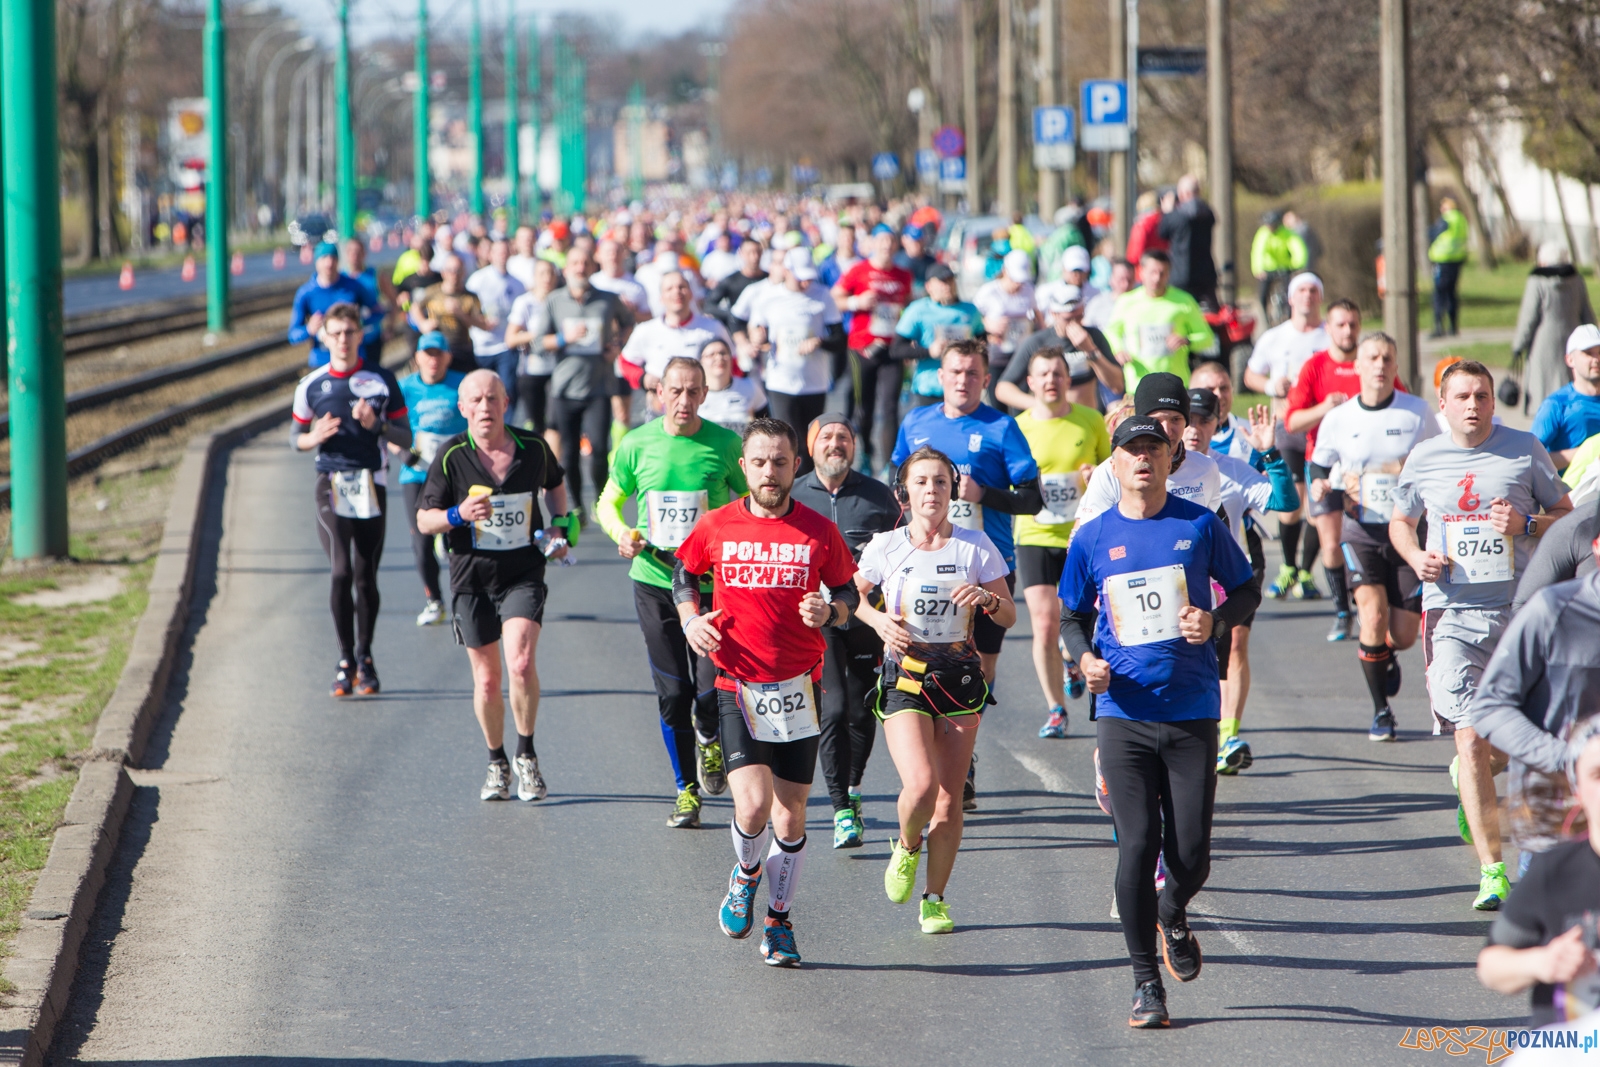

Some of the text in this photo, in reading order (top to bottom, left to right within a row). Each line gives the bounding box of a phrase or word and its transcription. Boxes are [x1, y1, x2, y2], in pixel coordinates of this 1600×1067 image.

[1091, 83, 1121, 122] P
[1041, 110, 1068, 141] P
[658, 507, 698, 523] 7937
[948, 504, 972, 518] 23
[722, 541, 811, 564] POLISH
[1457, 538, 1504, 557] 8745
[722, 564, 809, 590] POWER
[914, 599, 958, 616] 8271
[1136, 591, 1162, 612] 10
[756, 692, 806, 716] 6052
